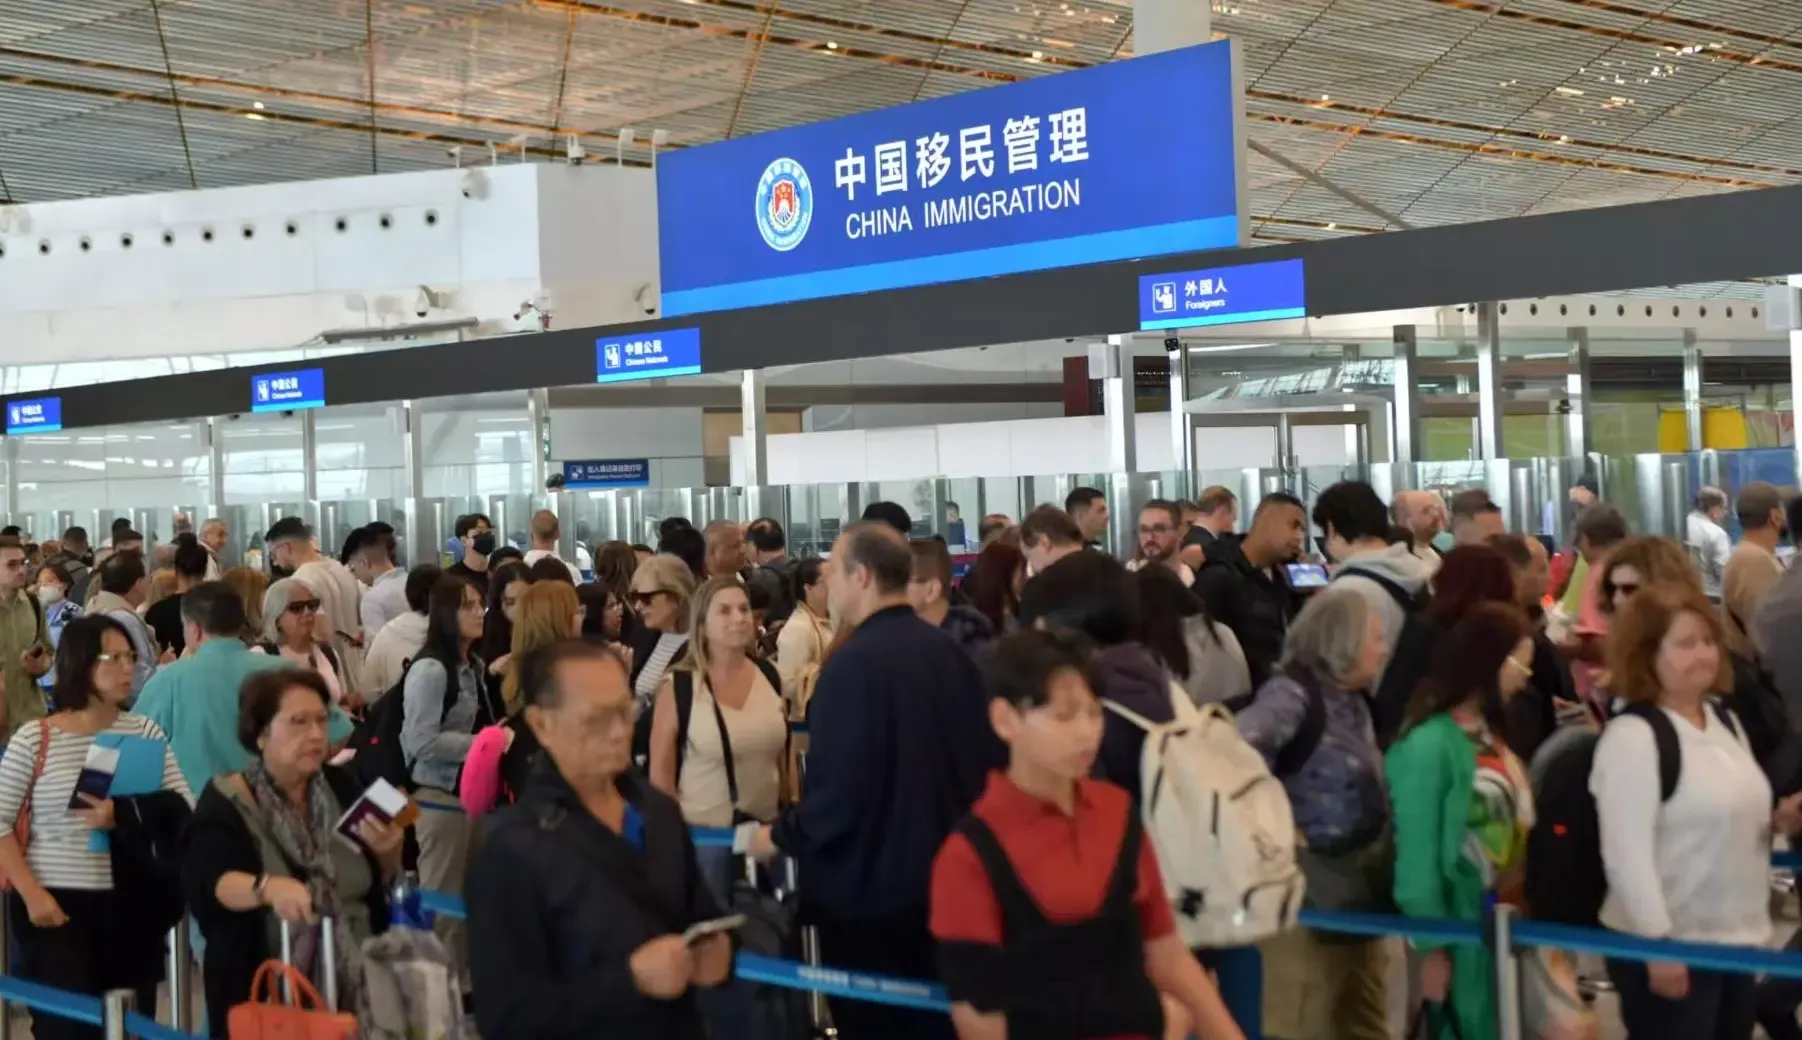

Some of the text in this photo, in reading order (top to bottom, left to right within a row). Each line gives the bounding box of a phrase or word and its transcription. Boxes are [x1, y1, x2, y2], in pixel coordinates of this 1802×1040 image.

[835, 107, 1089, 201] 中国移民管理
[846, 205, 913, 239] CHINA
[924, 178, 1080, 228] IMMIGRATION
[1185, 278, 1228, 297] 外国人
[1186, 299, 1225, 311] Foreigners
